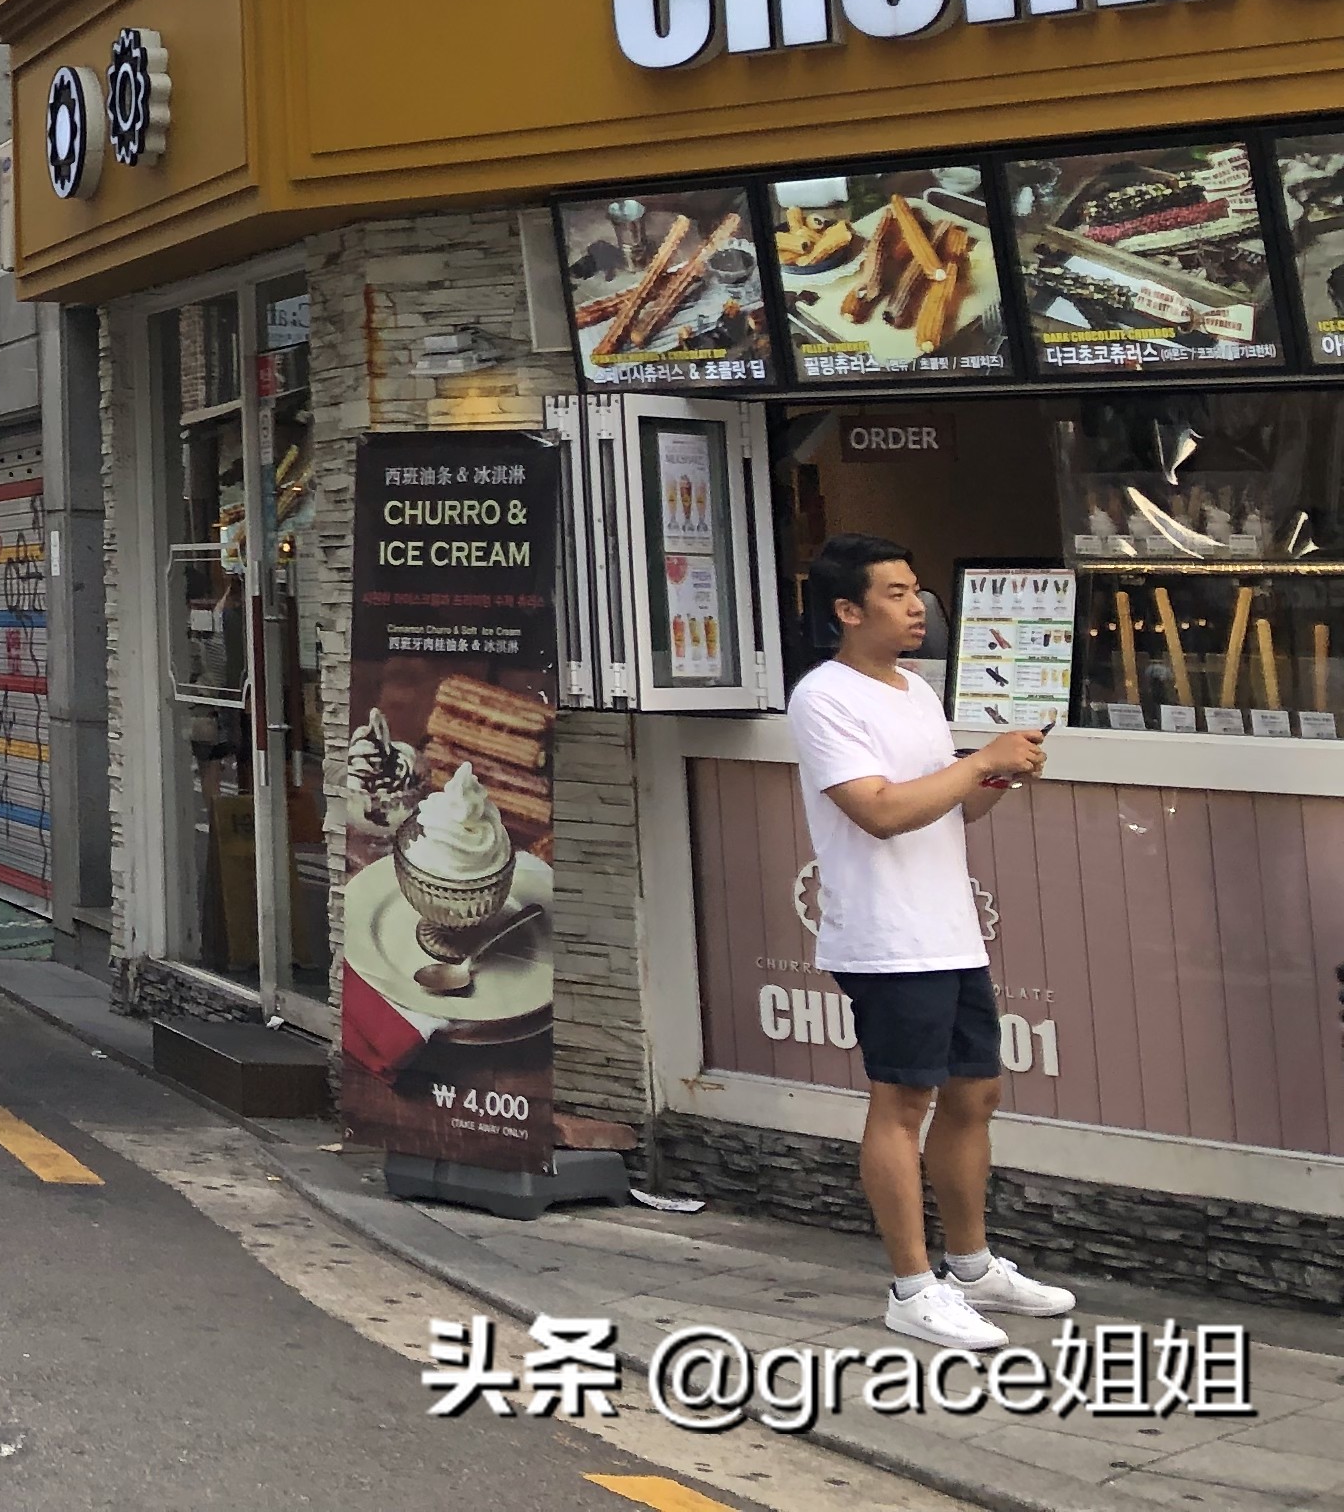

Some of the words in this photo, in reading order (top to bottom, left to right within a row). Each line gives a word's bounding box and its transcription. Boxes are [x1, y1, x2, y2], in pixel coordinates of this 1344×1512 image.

[1071, 329, 1126, 343] CHOCOLATE
[1317, 318, 1337, 332] ICE
[803, 354, 881, 376] 필링츄러스
[1046, 342, 1160, 367] 다크초코츄러스
[689, 363, 700, 380] &
[705, 361, 745, 380] 초콜릿
[750, 359, 766, 379] 딥
[849, 427, 940, 450] ORDER
[456, 467, 470, 483] &
[473, 464, 526, 485] 冰淇淋
[383, 499, 501, 525] CHURRO
[507, 499, 527, 525] &
[379, 541, 424, 566] ICE
[430, 541, 530, 566] CREAM
[426, 624, 452, 635] Churro
[481, 626, 494, 636] Ice
[432, 1083, 457, 1109] ₩
[463, 1088, 529, 1121] 4,000
